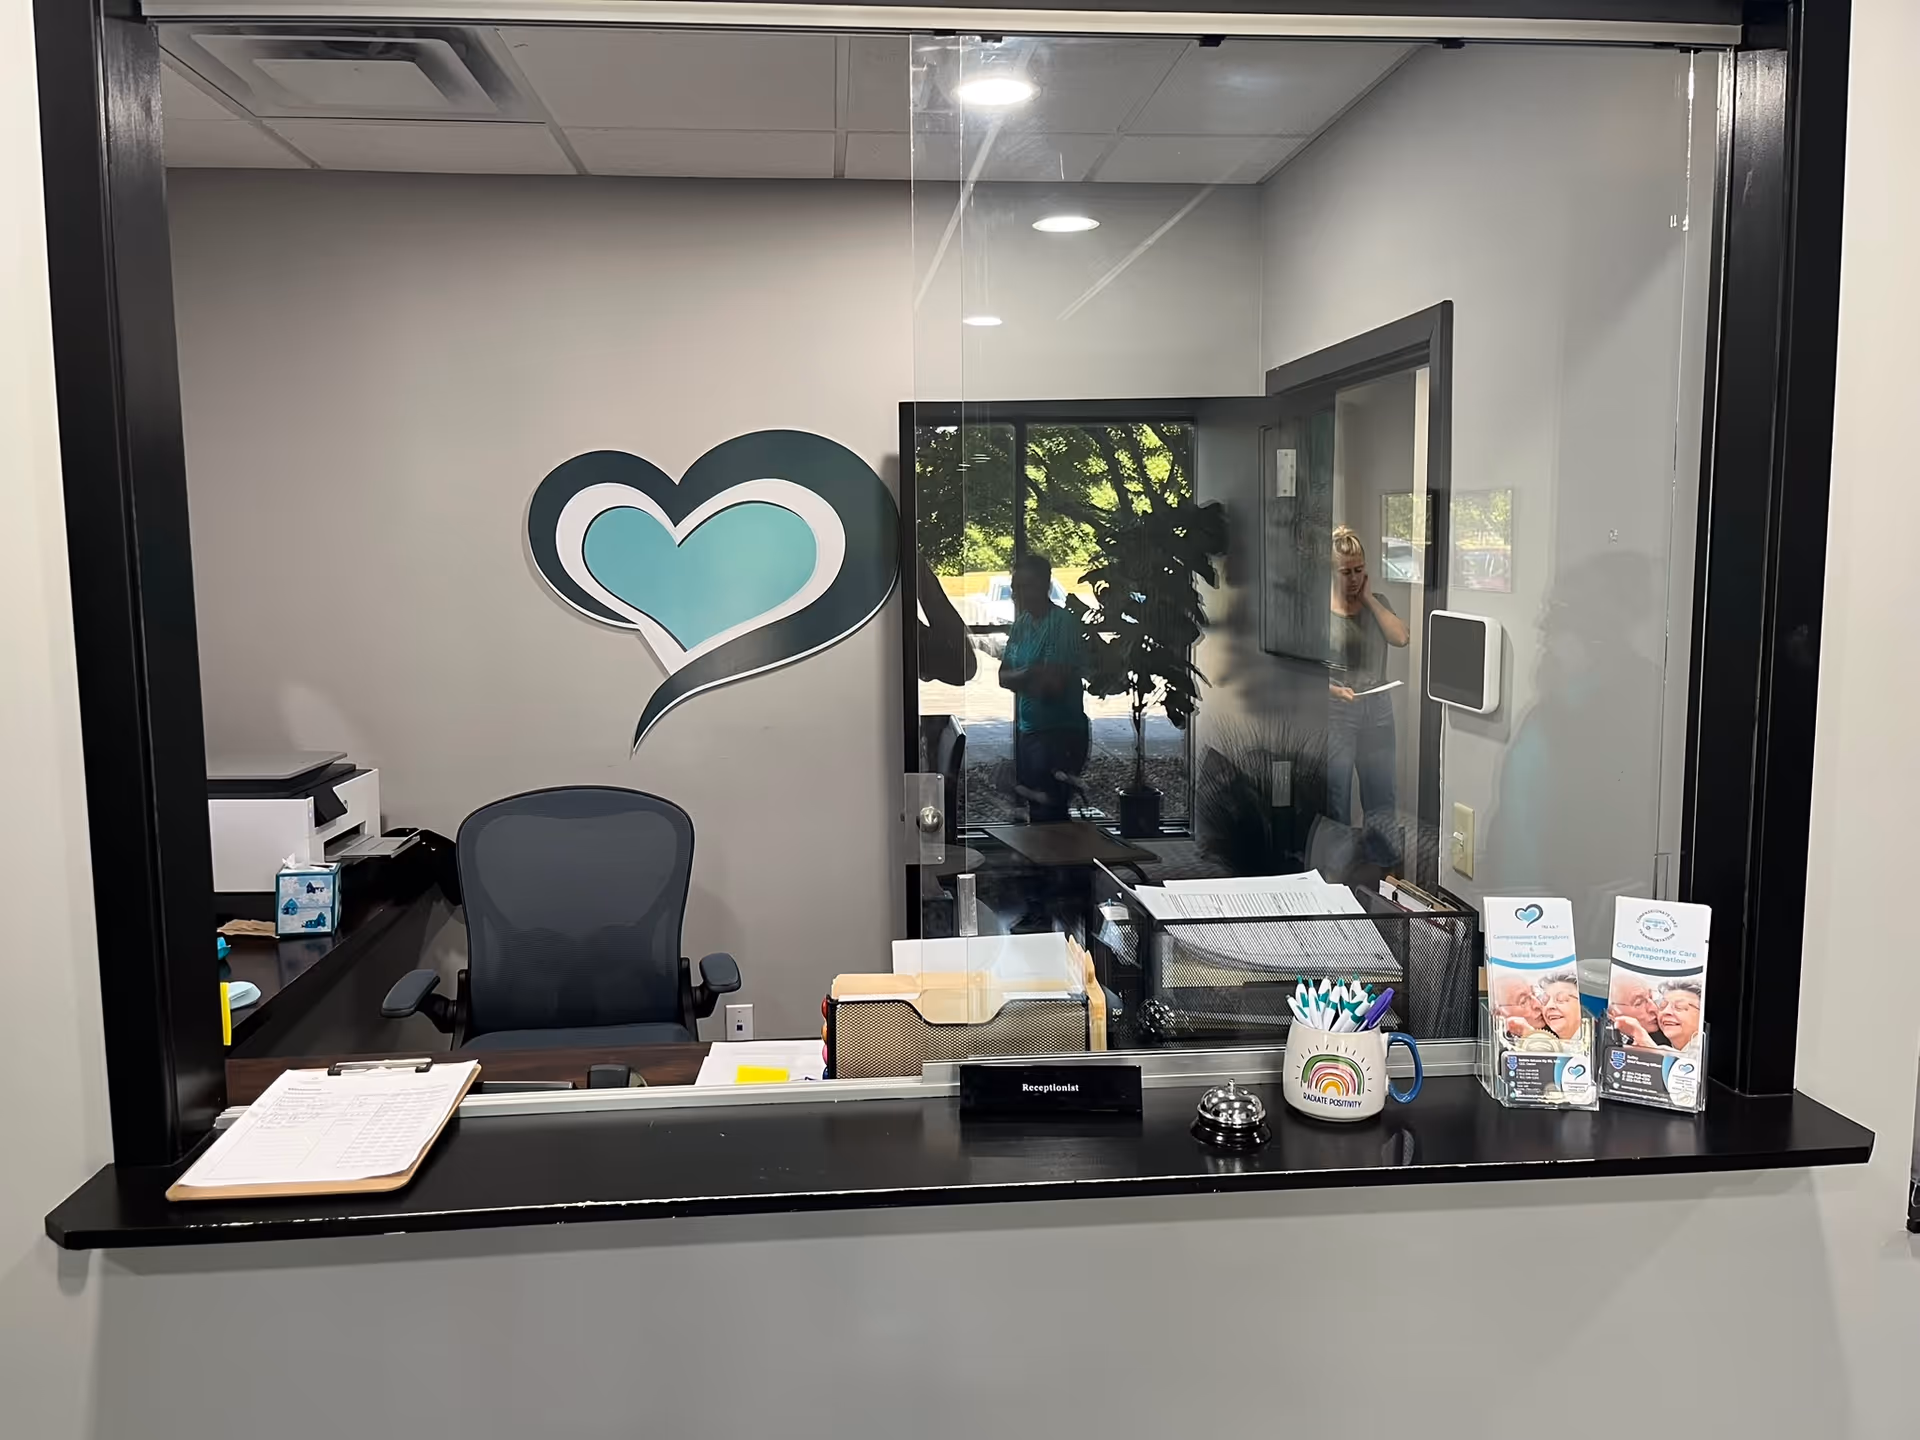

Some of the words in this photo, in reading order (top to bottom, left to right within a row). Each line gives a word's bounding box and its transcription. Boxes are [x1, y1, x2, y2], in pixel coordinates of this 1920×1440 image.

[1616, 942, 1677, 956] Compassionate
[1678, 950, 1697, 958] Care
[1628, 951, 1686, 965] Transportation
[1022, 1083, 1079, 1093] Receptionist
[1303, 1092, 1328, 1104] RADIATE
[1330, 1098, 1362, 1108] POSITIVITY
